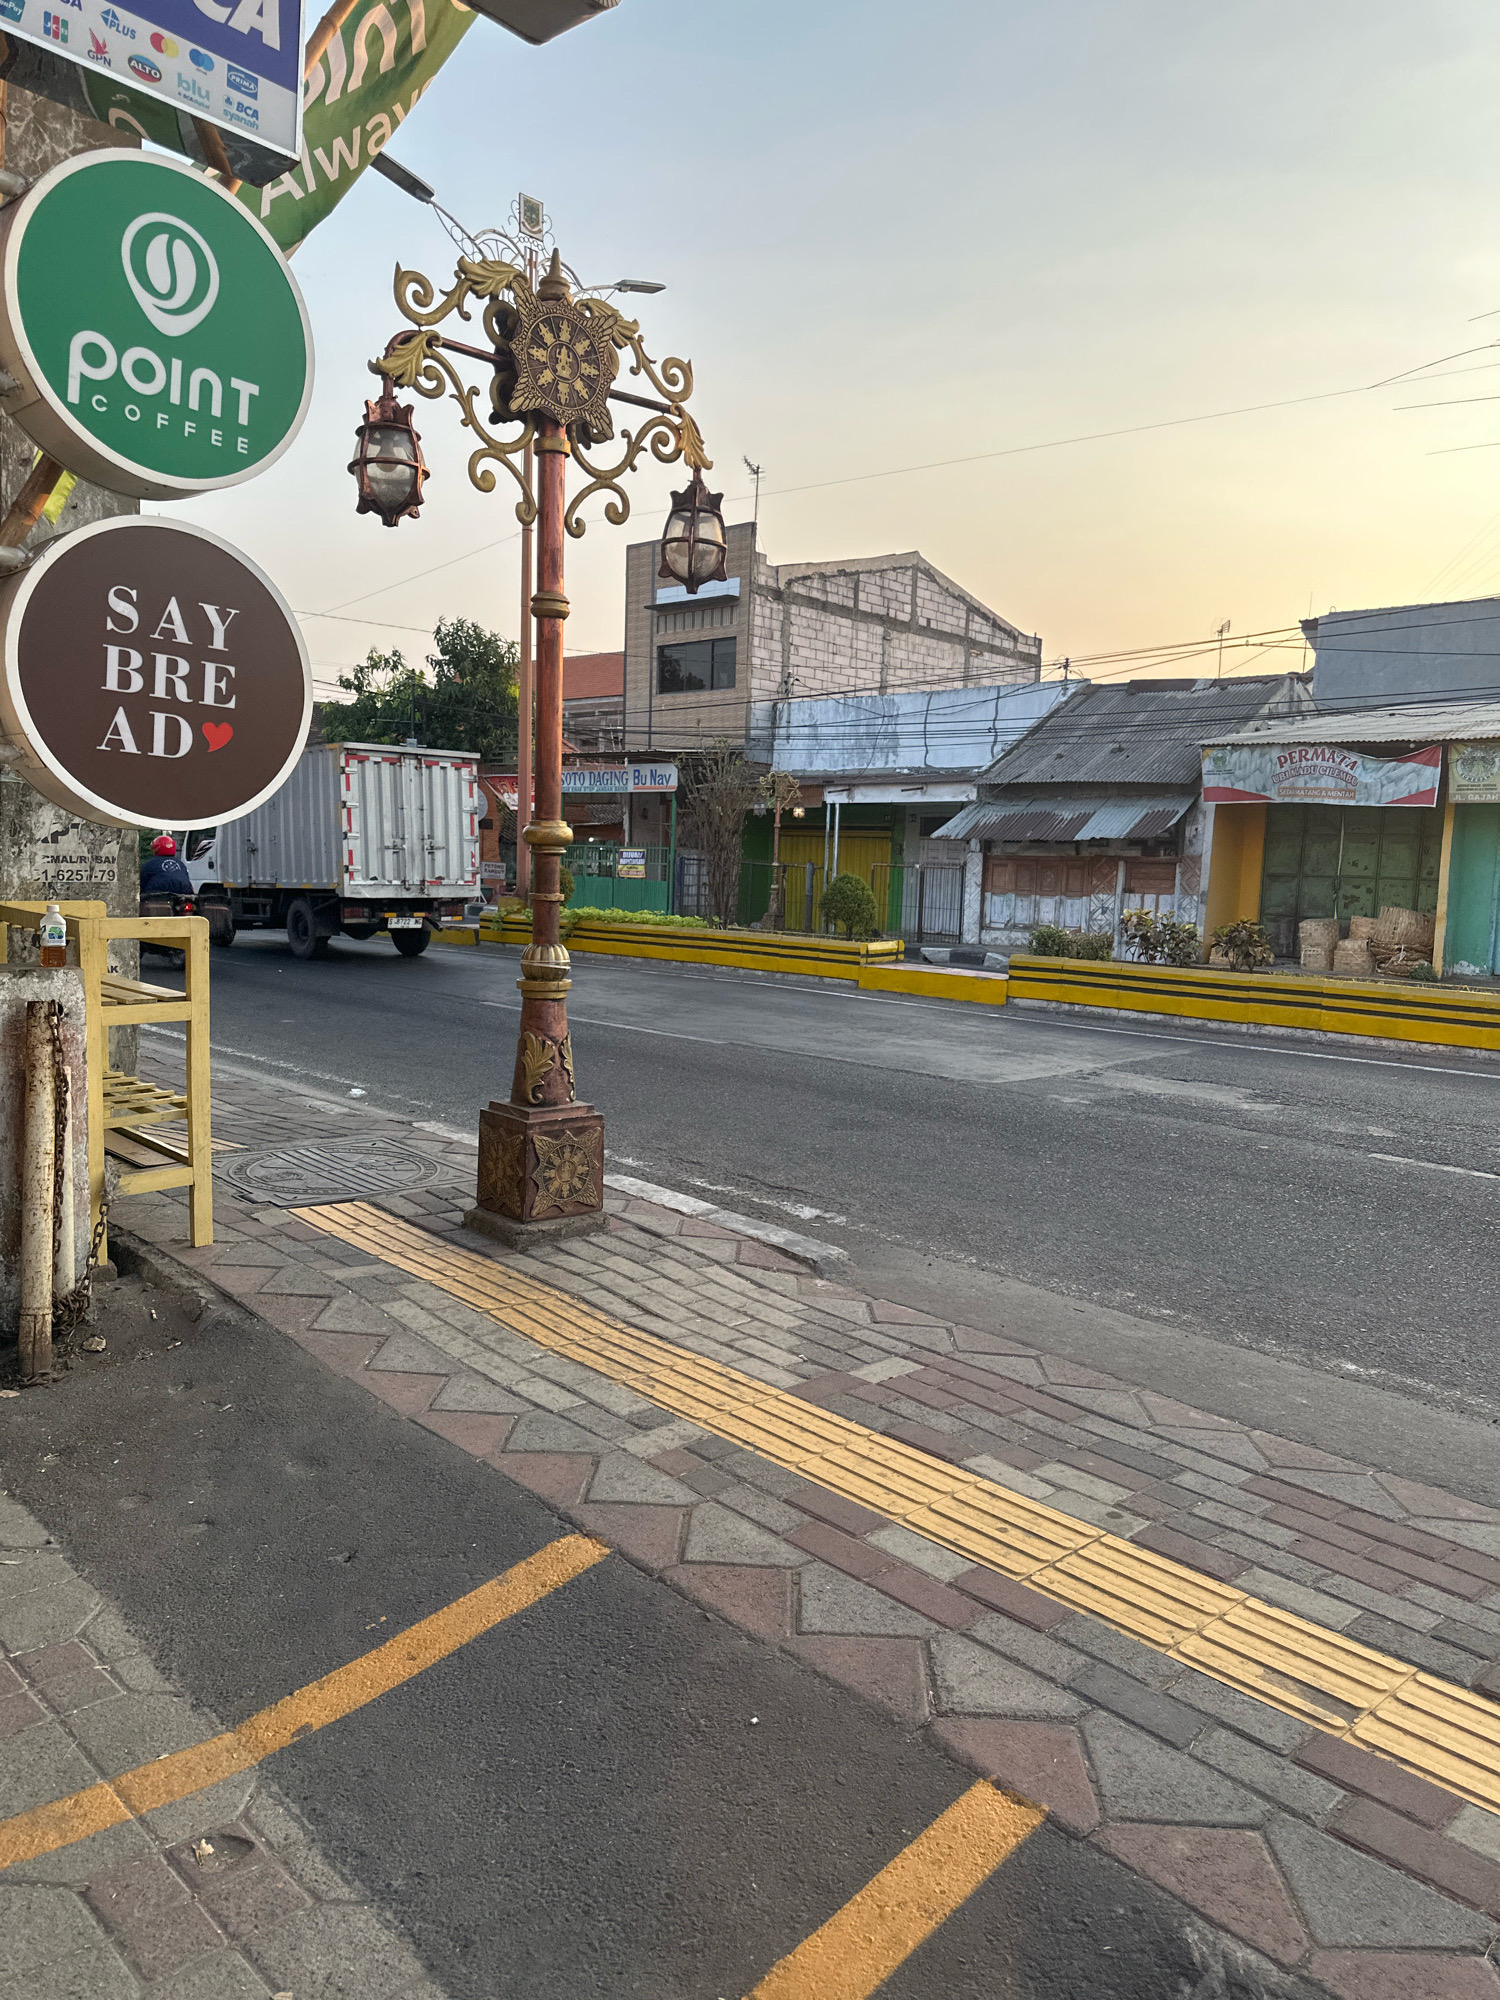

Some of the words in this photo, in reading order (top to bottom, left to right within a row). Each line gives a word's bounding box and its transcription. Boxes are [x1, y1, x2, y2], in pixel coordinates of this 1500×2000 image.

[108, 21, 136, 39] PLUS
[87, 49, 112, 67] GPN
[130, 60, 160, 78] ALTO
[177, 72, 210, 102] blu
[230, 74, 255, 90] PRIMA
[235, 101, 259, 121] BCA
[91, 394, 249, 454] COFFEE
[106, 585, 240, 651] SAY
[101, 644, 236, 709] BRE
[96, 706, 193, 758] AD
[1277, 747, 1358, 771] PERMATA
[561, 771, 585, 786] SOTO
[588, 771, 629, 786] DAGING
[633, 769, 647, 786] Bu
[650, 769, 671, 789] Nay
[1271, 770, 1289, 784] UBI
[1289, 765, 1318, 779] MADU
[1319, 766, 1358, 787] CILEMBU
